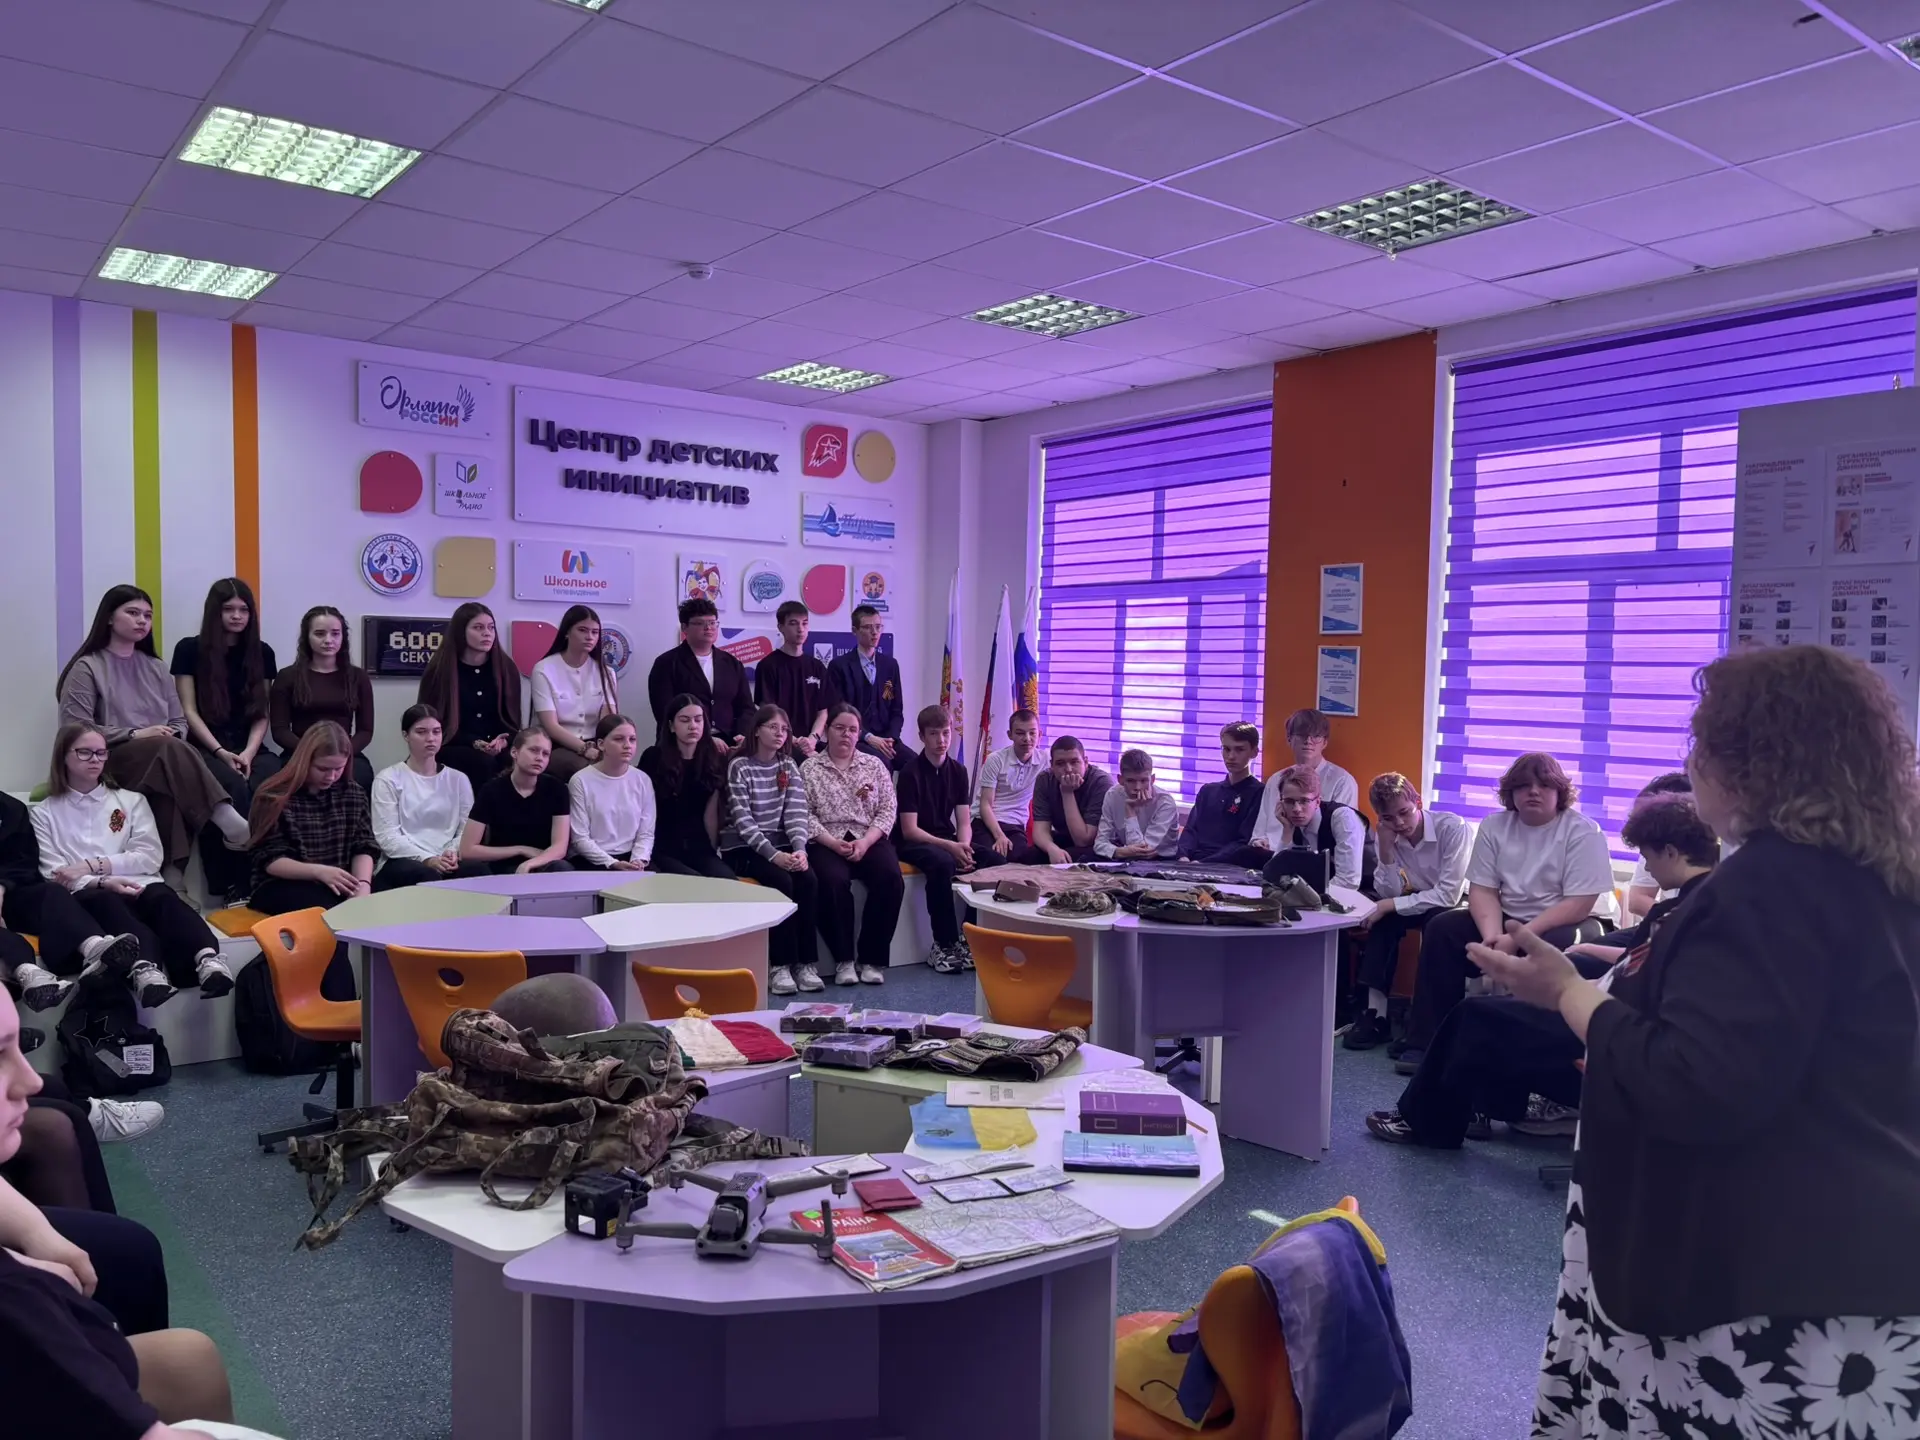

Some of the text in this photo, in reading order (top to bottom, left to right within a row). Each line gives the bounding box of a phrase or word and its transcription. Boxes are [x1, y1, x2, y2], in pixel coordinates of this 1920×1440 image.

[380, 375, 460, 417] Орлята
[400, 408, 460, 428] РОССИИ
[528, 418, 780, 474] Центр детских
[563, 467, 750, 506] инициатив
[543, 575, 608, 589] Школьное
[389, 631, 443, 650] 600
[810, 1216, 878, 1229] УРАЇНА
